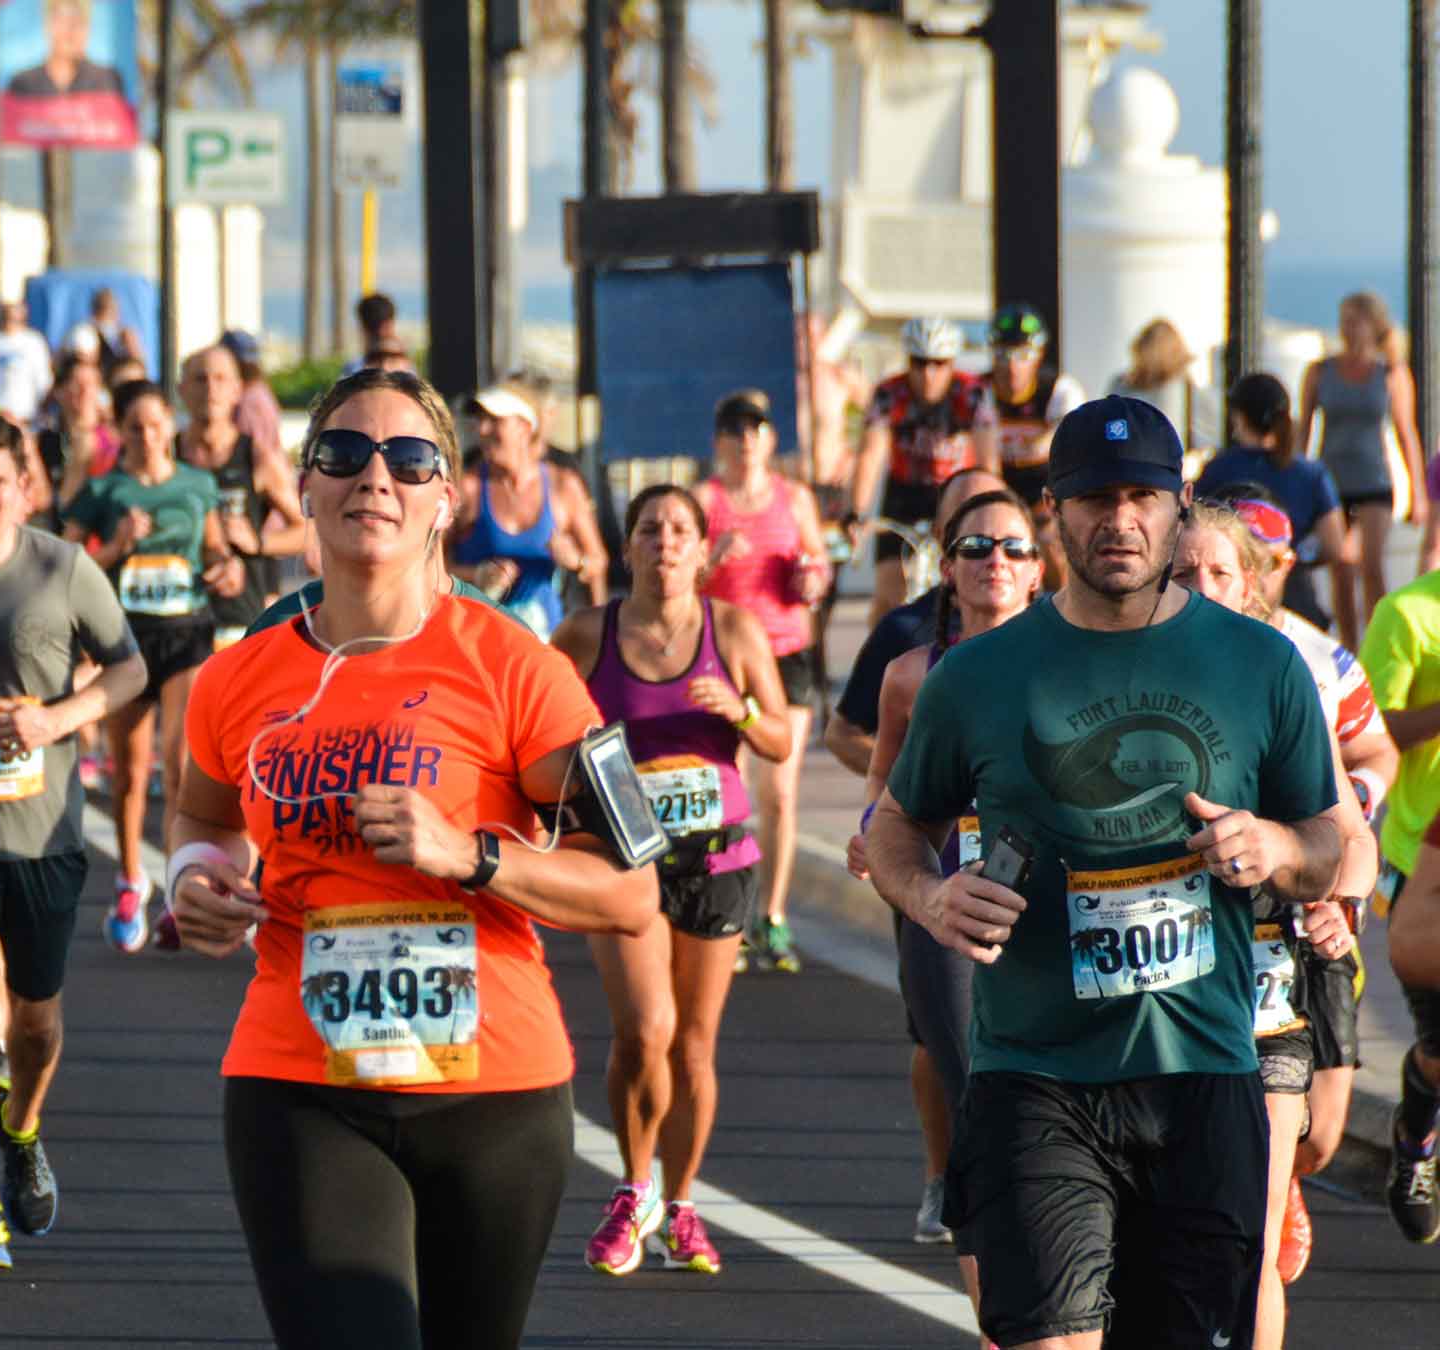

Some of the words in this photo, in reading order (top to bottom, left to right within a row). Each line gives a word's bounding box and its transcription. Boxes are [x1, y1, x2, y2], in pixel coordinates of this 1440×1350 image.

[185, 129, 231, 192] P
[1066, 697, 1118, 733] FORT
[1125, 690, 1232, 765] LAUDERDALE
[250, 745, 443, 802] FINISHER
[648, 791, 708, 823] 275
[1093, 912, 1197, 975] 3007
[321, 966, 453, 1023] 3493
